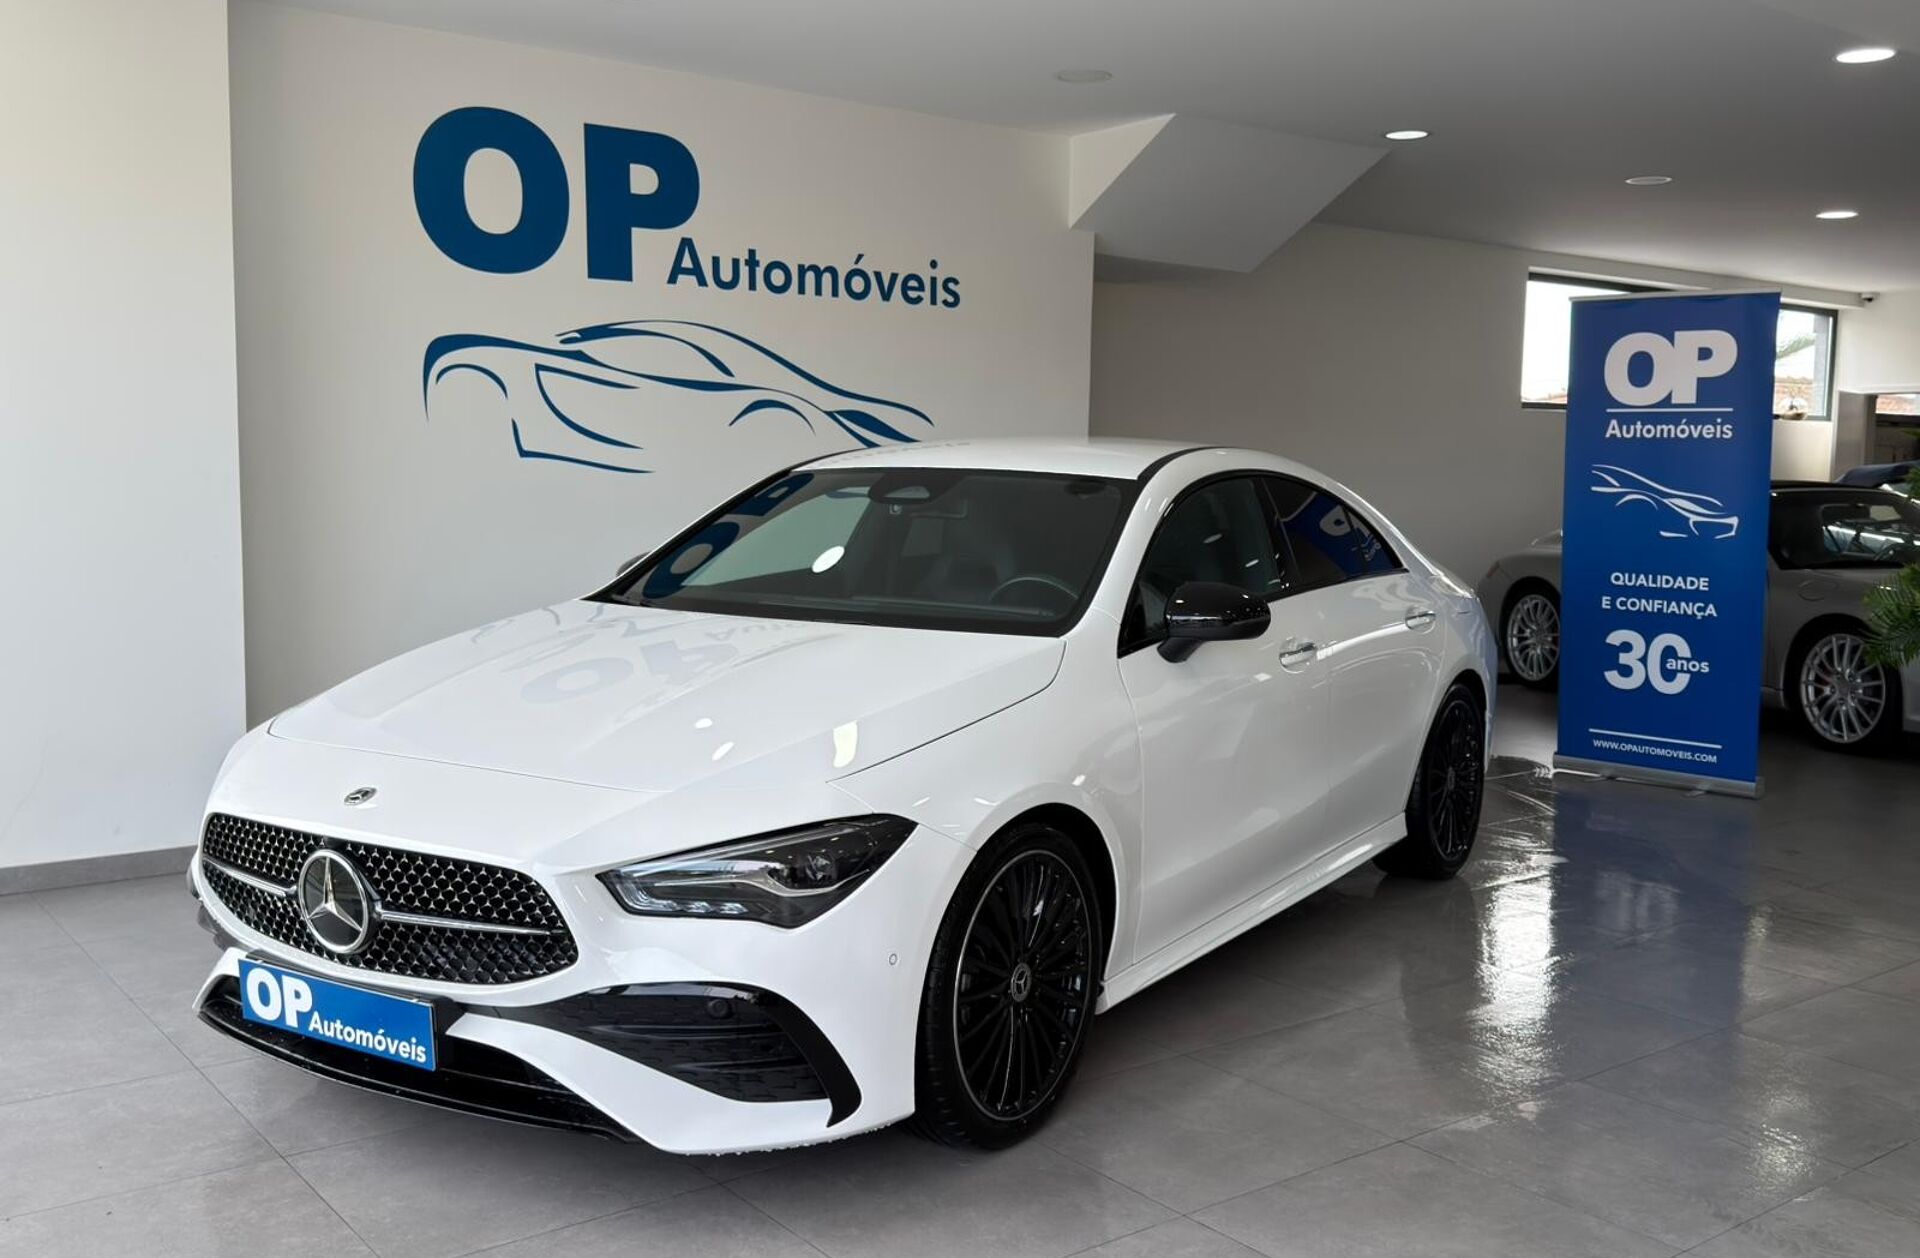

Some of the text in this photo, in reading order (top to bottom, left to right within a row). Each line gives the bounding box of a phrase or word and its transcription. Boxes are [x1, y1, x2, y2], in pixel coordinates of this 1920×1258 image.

[413, 106, 700, 282] OP
[667, 236, 961, 309] Automóveis
[1604, 329, 1738, 407] OP
[1605, 418, 1733, 438] Automóveis
[1602, 596, 1717, 619] E CONFIANÇA
[1610, 572, 1709, 591] QUALIDADE
[1604, 629, 1692, 695] 30
[1666, 658, 1710, 673] anos
[1593, 739, 1717, 763] WWW.OPAUTOMOVEIS.COM
[246, 968, 313, 1028] OP
[308, 1011, 426, 1063] Automóveis
